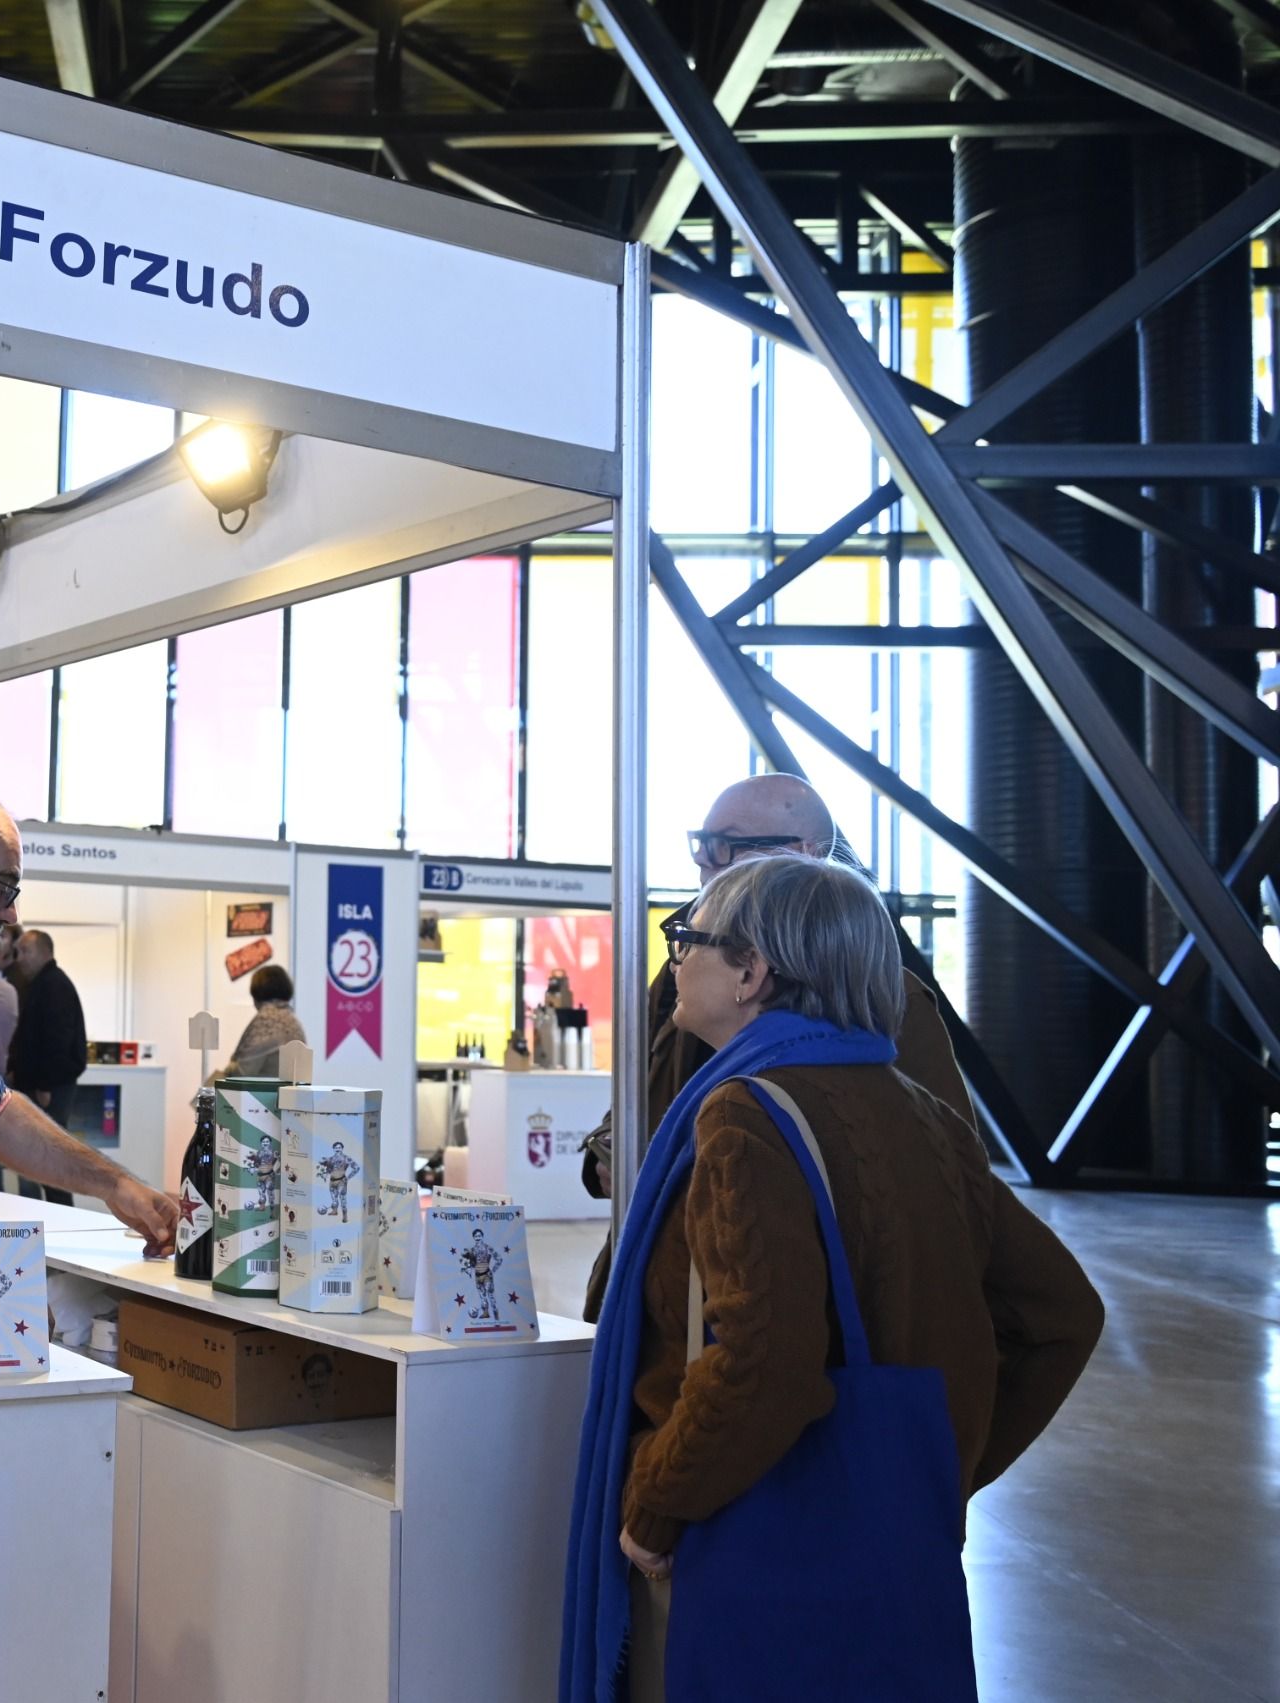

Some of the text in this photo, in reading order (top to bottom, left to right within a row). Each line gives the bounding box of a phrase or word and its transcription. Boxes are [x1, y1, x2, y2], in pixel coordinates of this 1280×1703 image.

[0, 200, 310, 328] Forzudo
[61, 844, 117, 859] Santos
[338, 904, 373, 919] ISLA
[339, 940, 372, 978] 23
